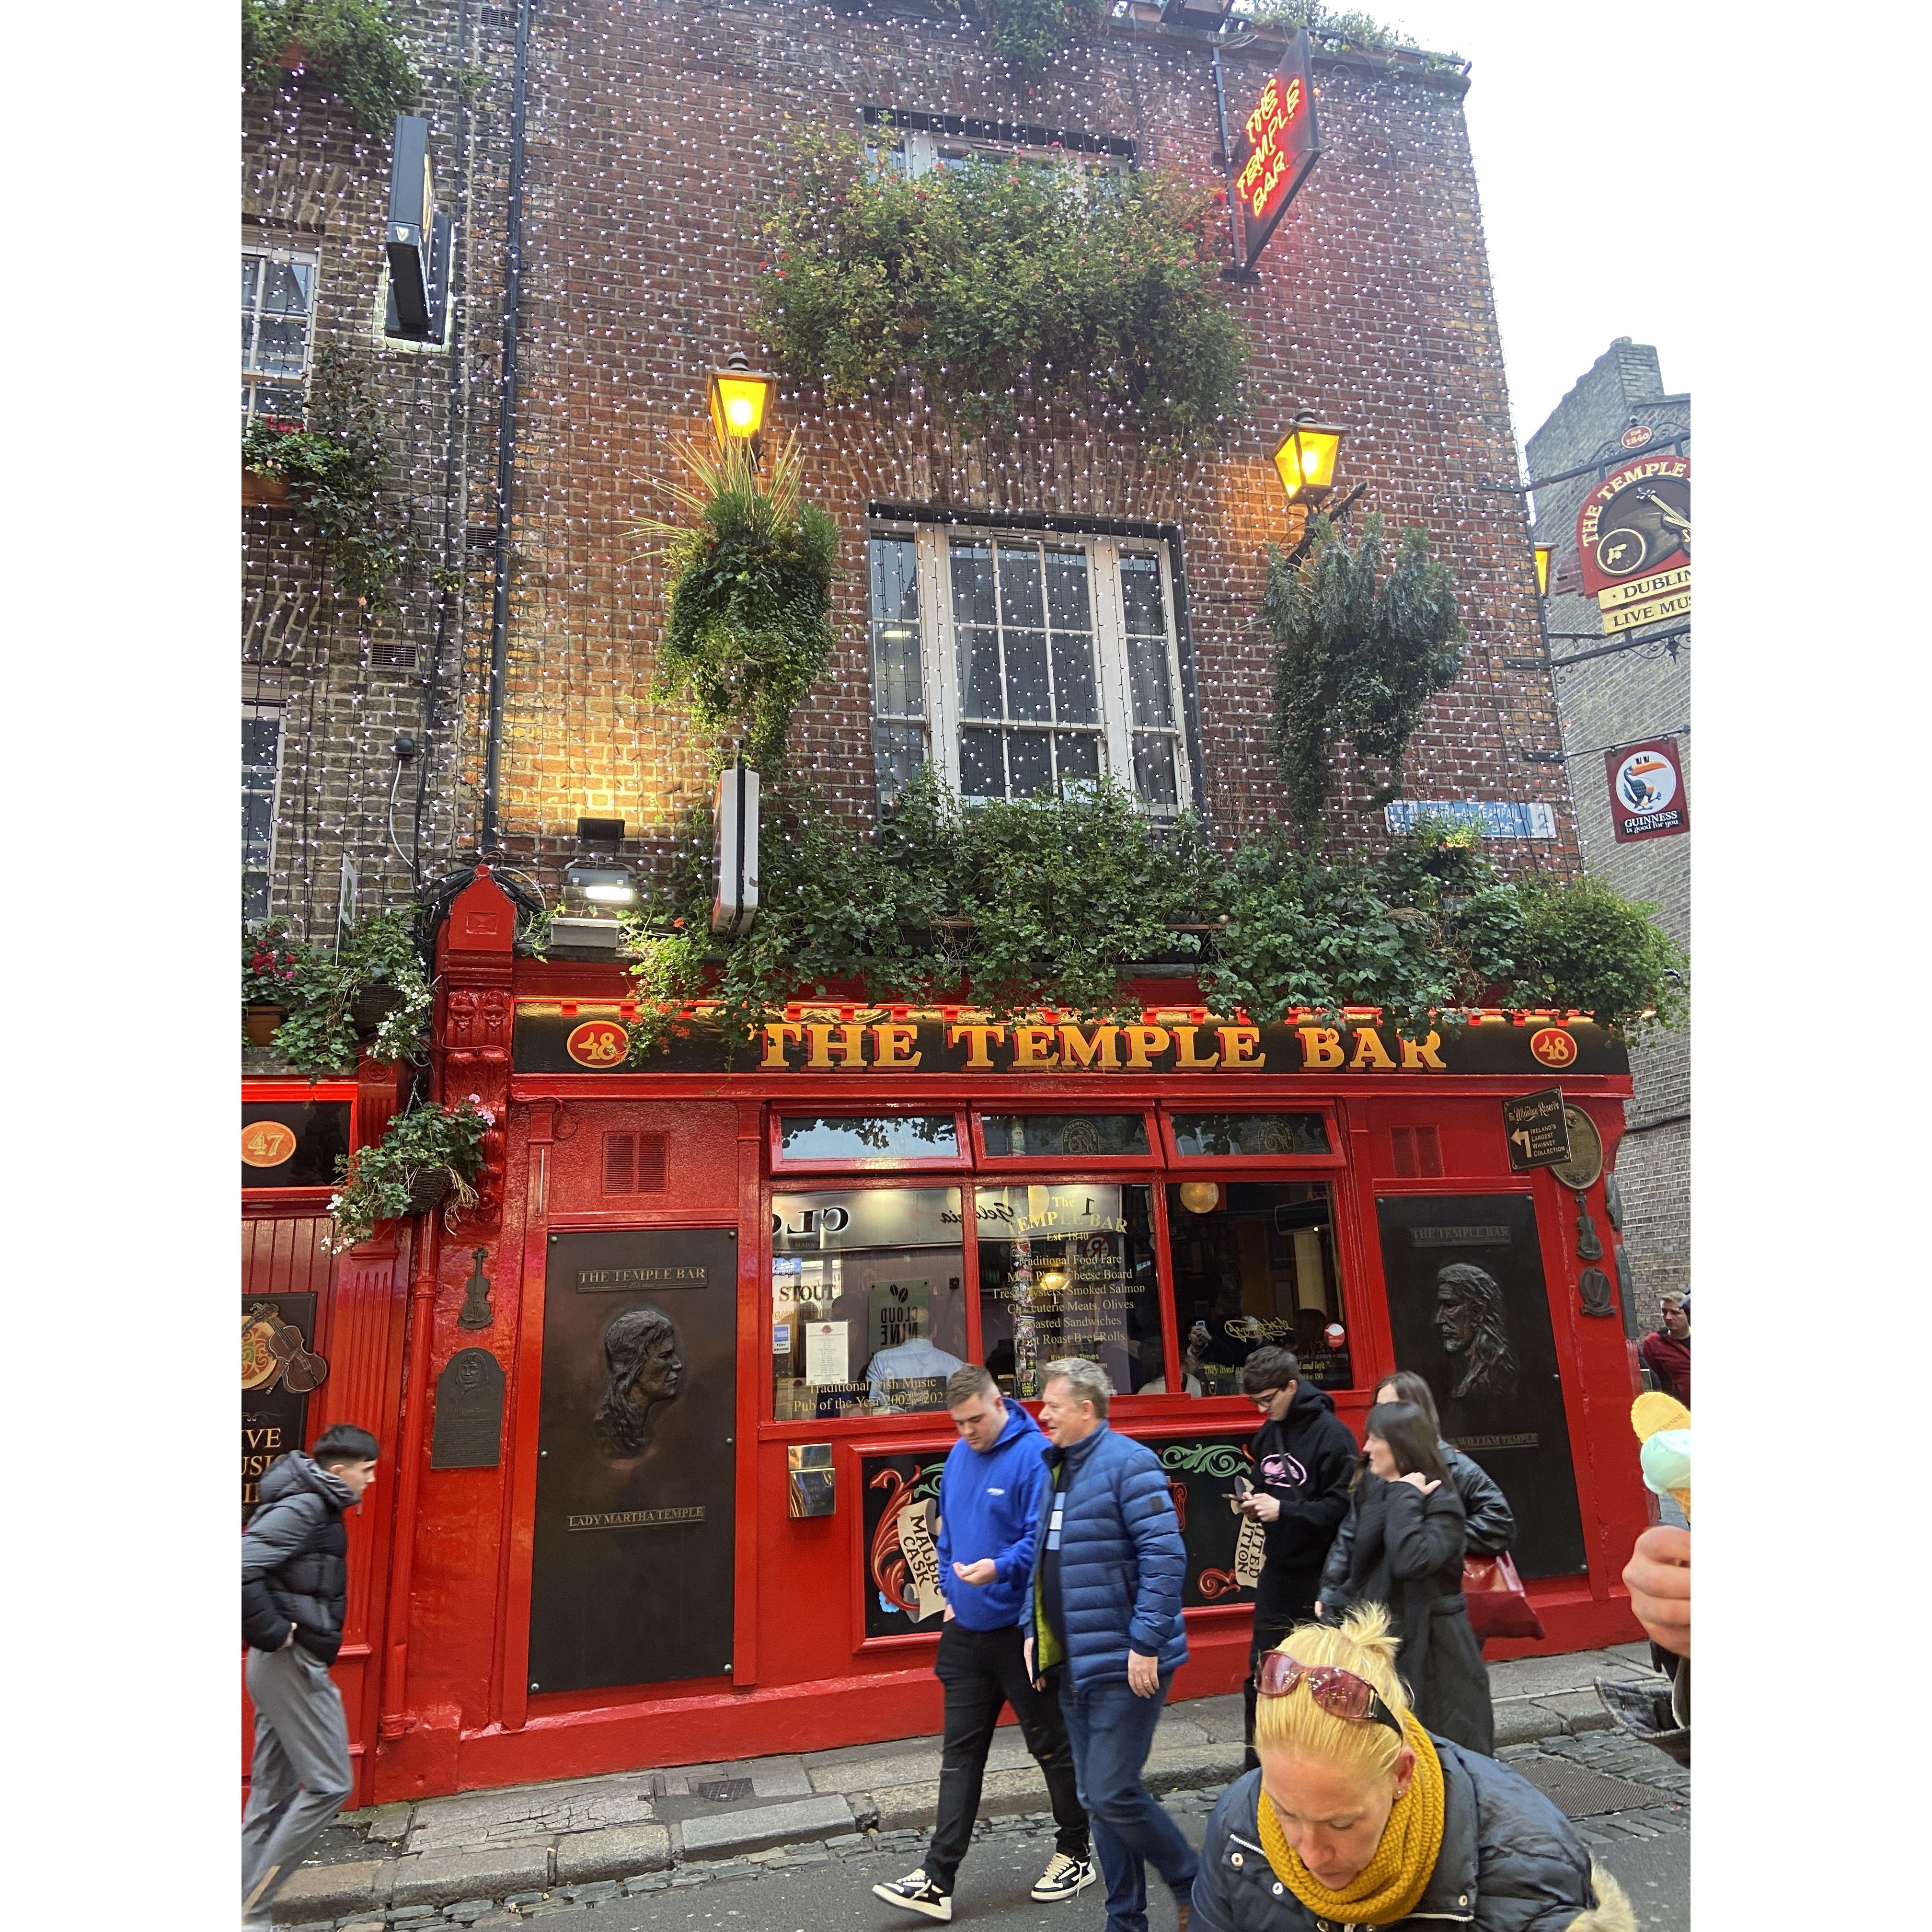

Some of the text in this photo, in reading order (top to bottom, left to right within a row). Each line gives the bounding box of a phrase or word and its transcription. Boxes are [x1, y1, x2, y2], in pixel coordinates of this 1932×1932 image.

[1245, 78, 1278, 143] THE
[1237, 79, 1300, 199] TEMPLE
[1252, 150, 1289, 217] BAR
[1626, 432, 1649, 446] 1840
[1582, 461, 1687, 547] THE TEMPLE
[1613, 596, 1690, 627] LIVE MU
[1537, 813, 1550, 830] 2
[1624, 810, 1678, 828] GUINNESS
[1634, 824, 1651, 834] good
[1665, 819, 1679, 828] you
[578, 1031, 619, 1061] 48
[748, 1023, 1446, 1070] THE TEMPLE BAR
[1538, 1031, 1569, 1061] 48
[1514, 1105, 1539, 1124] Whiskey
[1538, 1101, 1560, 1117] Reserve
[247, 1131, 284, 1157] 47
[1531, 1132, 1554, 1142] LARGEST
[1532, 1140, 1555, 1149] WHISKEY
[1533, 1145, 1565, 1157] COLLECTION
[1052, 1196, 1075, 1208] The
[1004, 1211, 1127, 1236] TEMPLE BAR
[1046, 1232, 1061, 1242] Est
[1413, 1227, 1509, 1239] THE TEMPLE BAR
[1018, 1254, 1122, 1266] Traditional Food Fare
[579, 1267, 705, 1284] THE TEMPLE BAR
[1065, 1270, 1101, 1281] Cheese
[1103, 1268, 1133, 1279] Board
[779, 1284, 835, 1302] STOUT
[1028, 1286, 1063, 1300] ysters,
[1067, 1285, 1106, 1295] Smoked
[1108, 1284, 1145, 1294] Salmon
[1068, 1301, 1100, 1312] Meats,
[1103, 1299, 1134, 1310] Olives
[1064, 1315, 1121, 1328] Sandwiches
[1043, 1334, 1070, 1345] Roast
[1074, 1332, 1095, 1343] Beef
[1101, 1331, 1126, 1342] Rolls
[1219, 1365, 1234, 1374] lived
[1302, 1361, 1314, 1370] and
[809, 1379, 870, 1394] Traditional
[901, 1377, 936, 1389] Music
[794, 1401, 816, 1412] Pub
[819, 1398, 833, 1410] of
[835, 1398, 852, 1409] the
[855, 1396, 881, 1409] Year
[1459, 1437, 1500, 1446] WILLIAM
[1503, 1435, 1538, 1445] TEMPLE
[569, 1506, 704, 1527] LADY MARTHA TEMPLE
[1249, 1525, 1265, 1579] ITED
[903, 1536, 931, 1588] CASK
